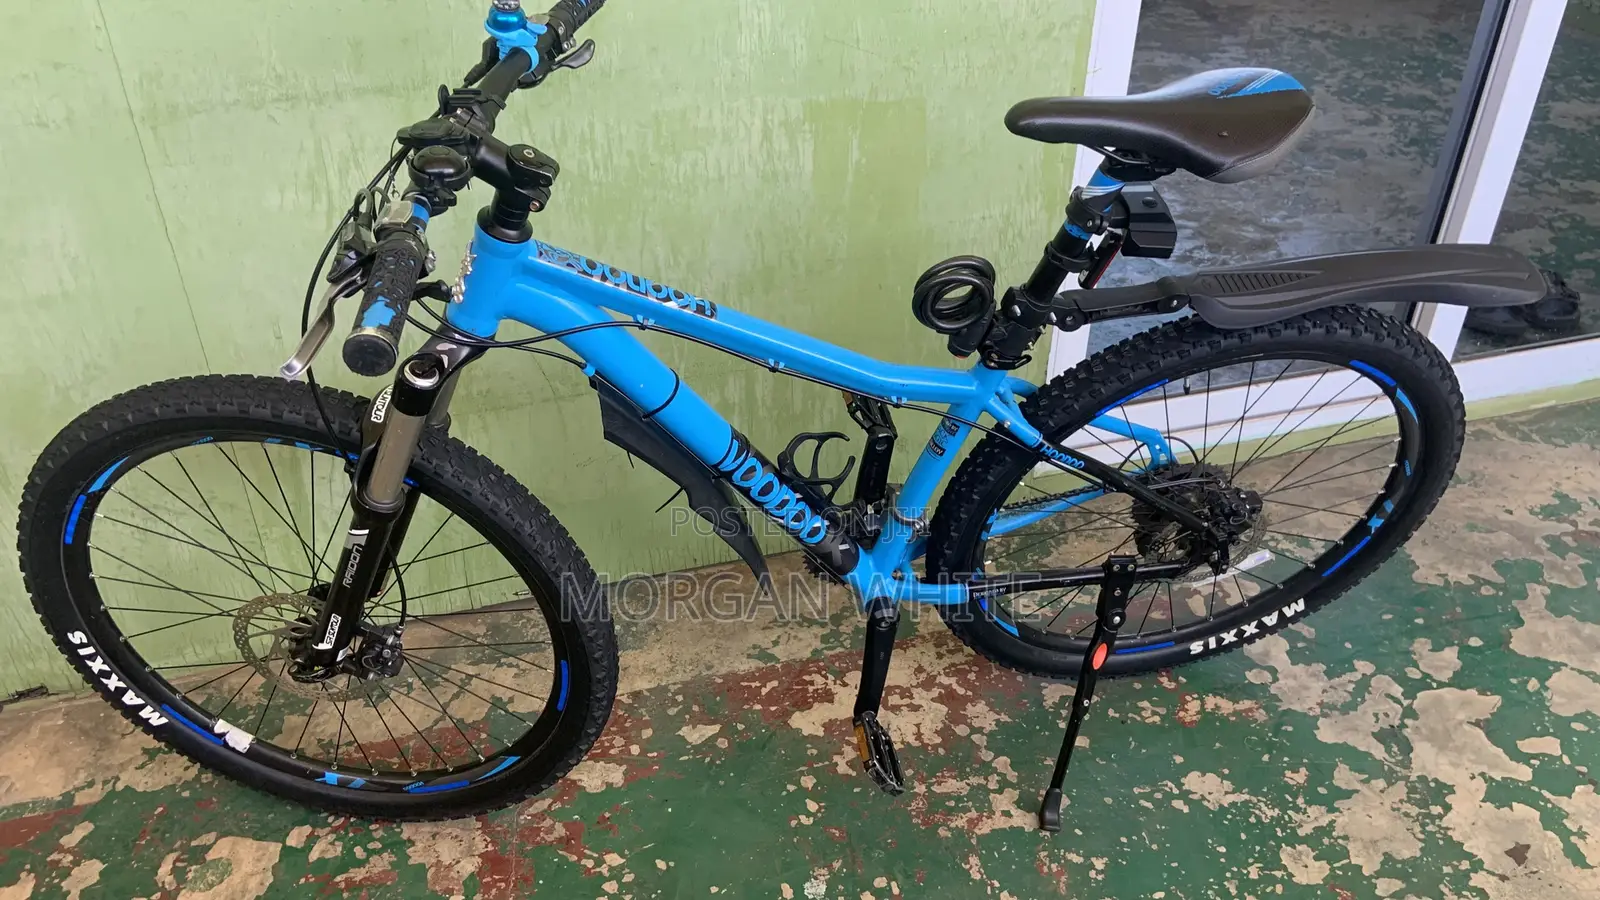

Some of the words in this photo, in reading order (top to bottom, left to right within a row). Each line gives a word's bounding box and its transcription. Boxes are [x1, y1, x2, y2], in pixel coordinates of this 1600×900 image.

[1040, 444, 1085, 468] HOODOO
[718, 438, 827, 544] VOODOO
[342, 544, 363, 589] RAIDON
[1189, 597, 1306, 655] MAXXIS
[66, 630, 170, 727] MAXXIS
